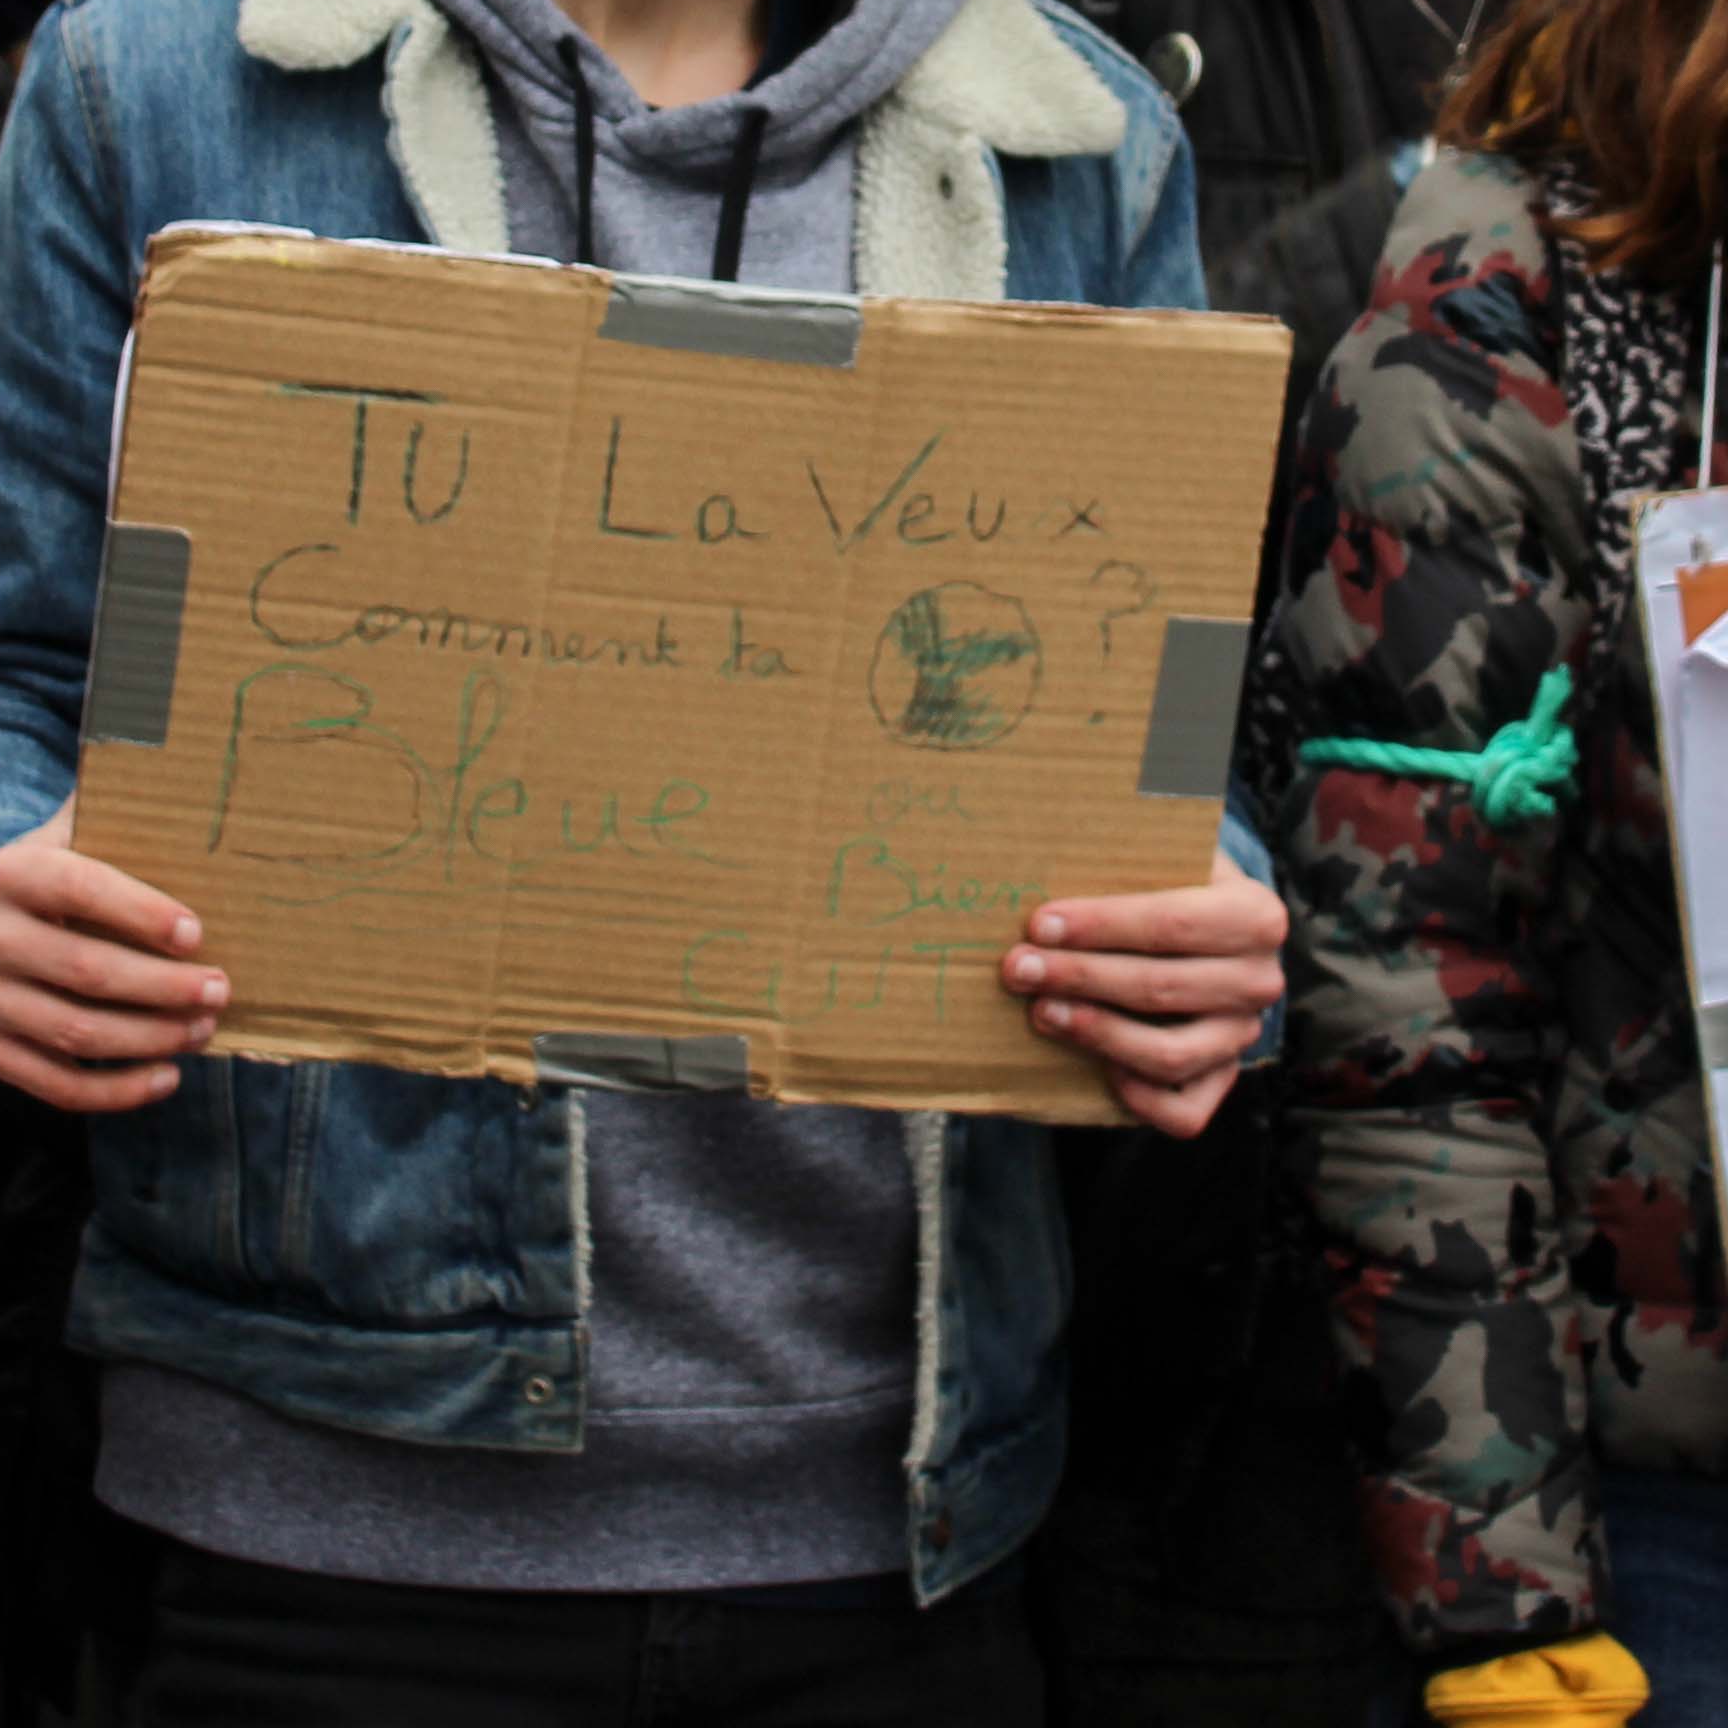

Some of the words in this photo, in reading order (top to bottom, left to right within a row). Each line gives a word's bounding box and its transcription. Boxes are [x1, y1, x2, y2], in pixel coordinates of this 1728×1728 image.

[275, 377, 474, 528] TU
[248, 542, 686, 666] Comment
[207, 662, 742, 884] Bleue
